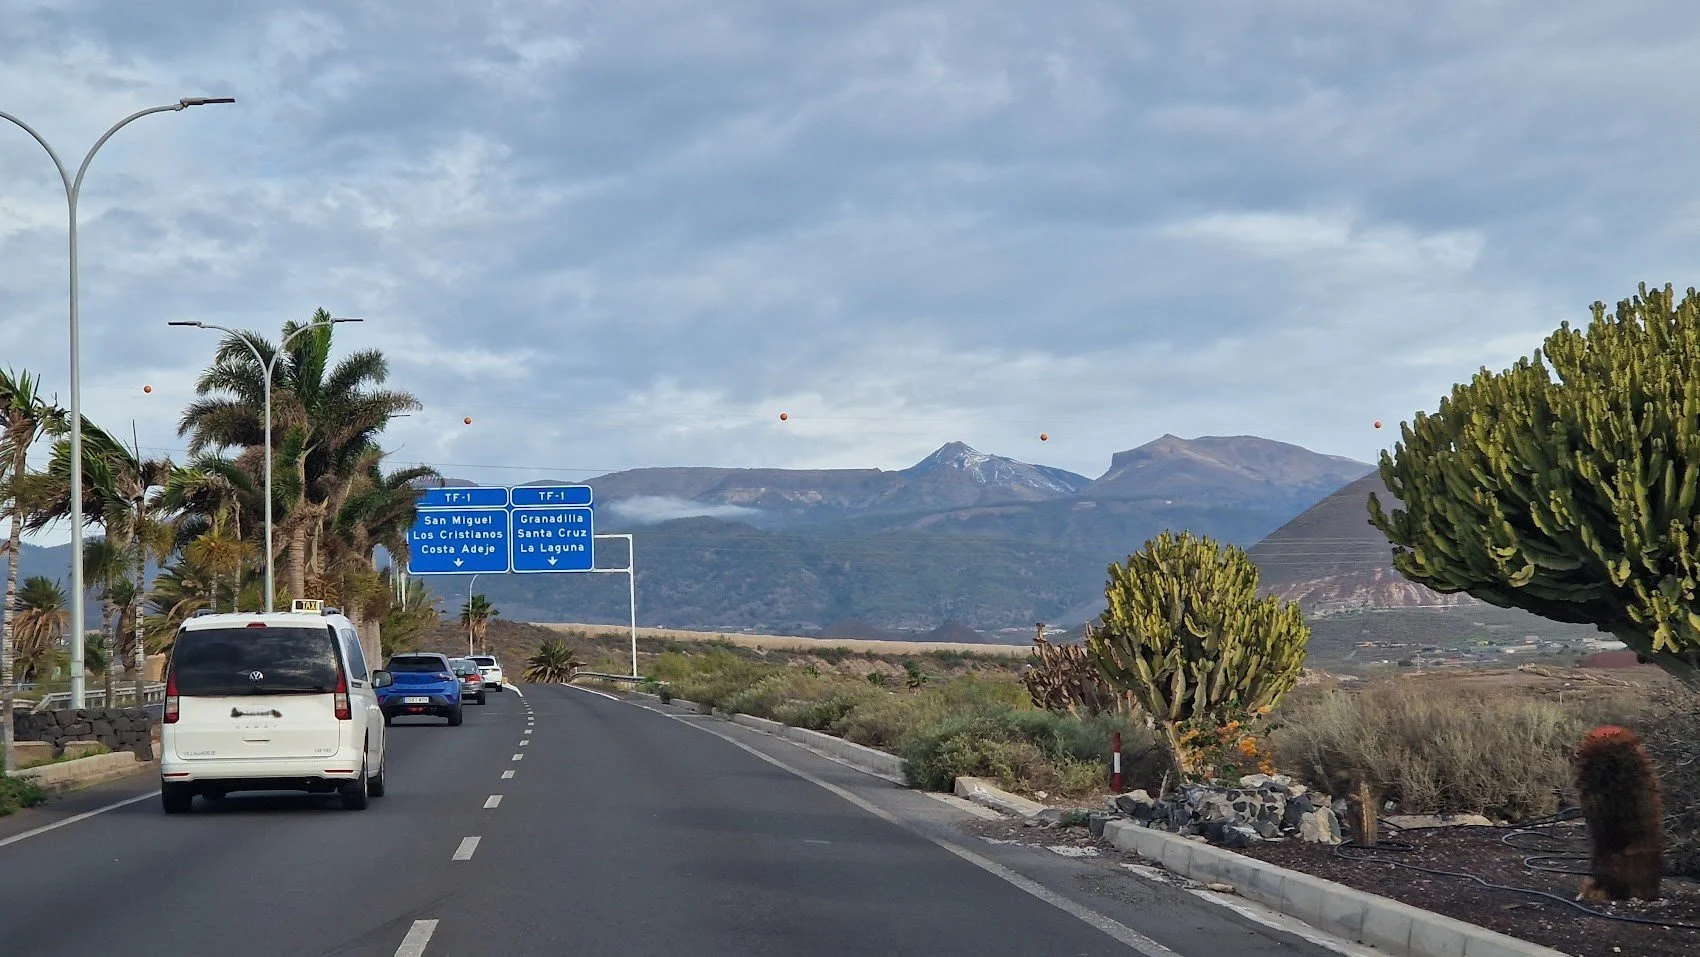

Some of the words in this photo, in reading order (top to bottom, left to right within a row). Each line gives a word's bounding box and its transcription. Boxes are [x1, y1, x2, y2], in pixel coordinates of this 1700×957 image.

[445, 492, 471, 502] TF-1
[539, 491, 565, 500] TF-1
[424, 516, 446, 525] San
[452, 516, 492, 527] Miguel
[520, 514, 583, 523] Granadilla
[413, 531, 434, 540] Los
[440, 530, 503, 540] Cristianos
[517, 529, 552, 538] Santa
[558, 528, 587, 537] Cruz
[421, 545, 455, 554] Costa
[461, 543, 496, 555] Adeje
[520, 543, 534, 552] La
[540, 543, 585, 554] Laguna
[302, 601, 319, 610] TAXI
